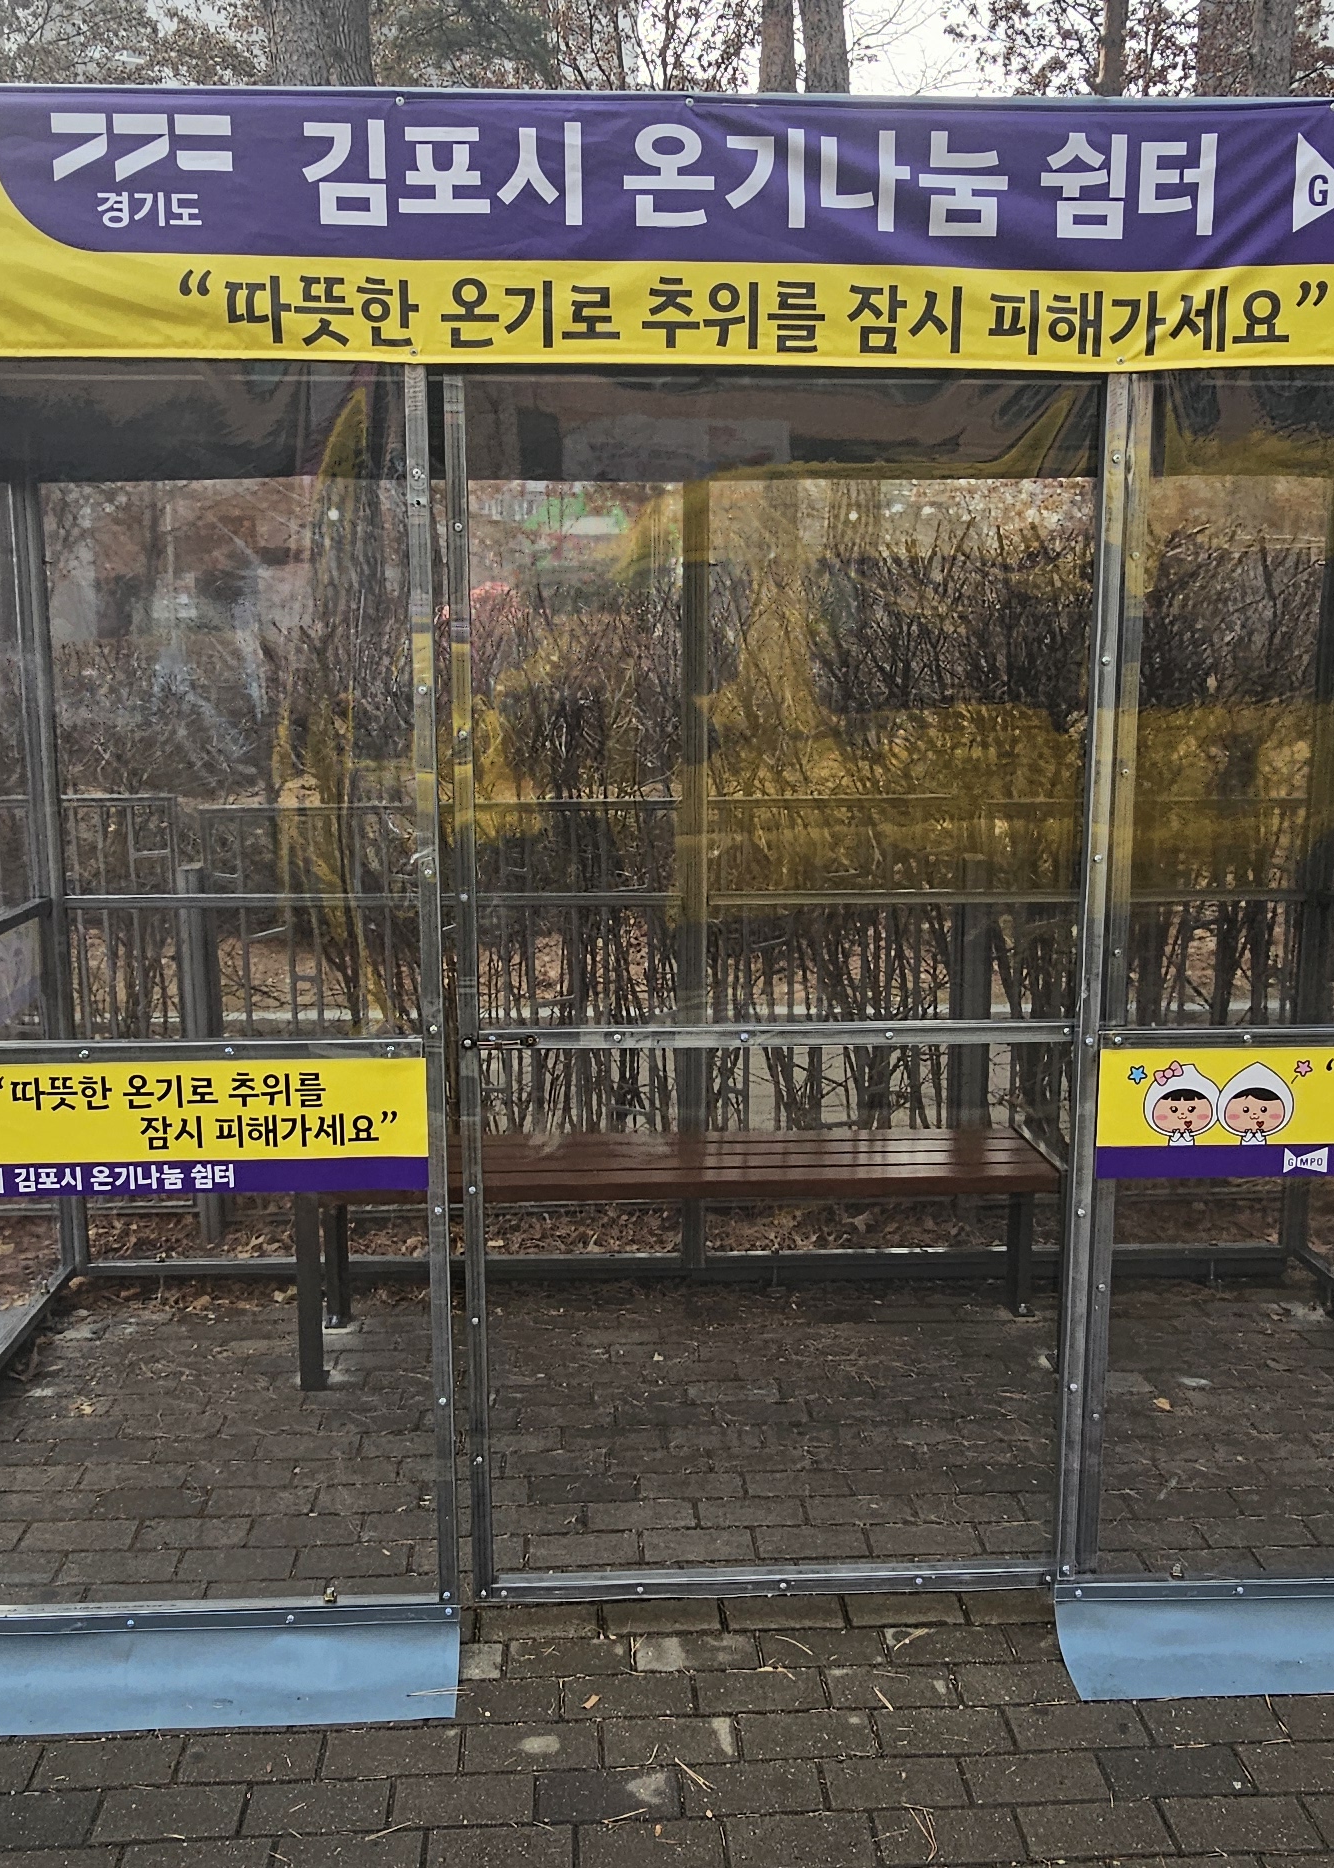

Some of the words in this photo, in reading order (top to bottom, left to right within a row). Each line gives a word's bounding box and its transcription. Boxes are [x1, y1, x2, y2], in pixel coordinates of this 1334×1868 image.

[301, 118, 583, 227] 김포시
[623, 122, 1009, 238] 온기나눔
[1040, 131, 1218, 240] 쉼터
[97, 191, 203, 228] 경기도
[440, 276, 621, 349] 온기로
[641, 275, 826, 354] 추위를
[847, 282, 964, 355] 잠시
[122, 1073, 220, 1109] 온기로
[228, 1072, 327, 1108] 추위를
[139, 1115, 204, 1151] 잠시
[14, 1166, 83, 1193] 김포시
[90, 1164, 185, 1191] 온기나눔
[190, 1163, 235, 1190] 쉼터
